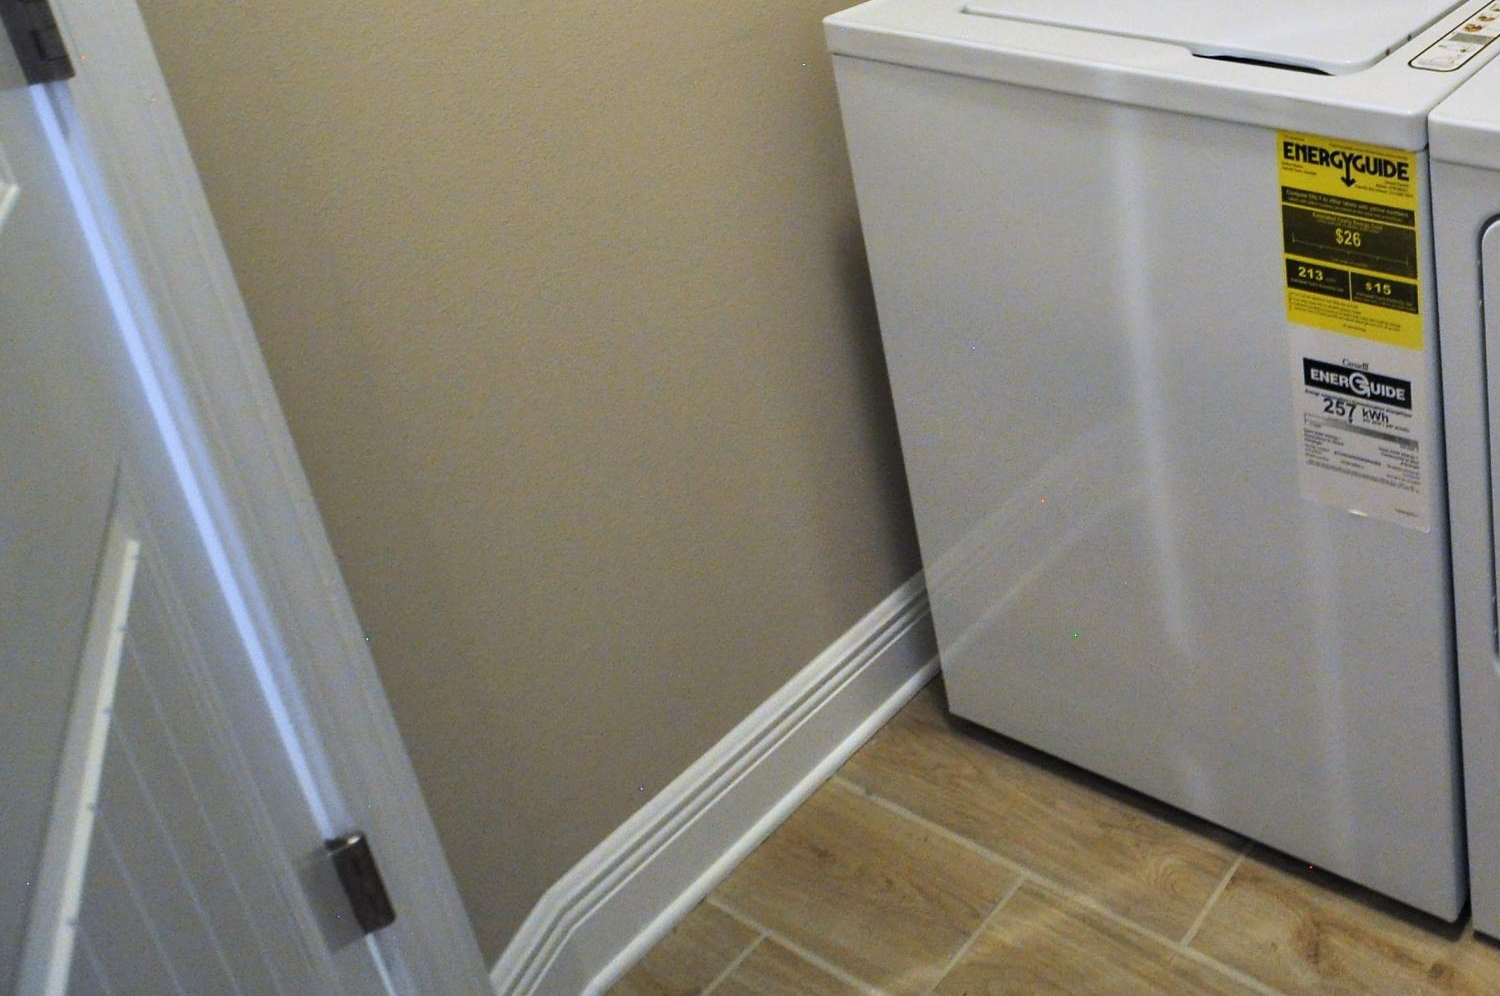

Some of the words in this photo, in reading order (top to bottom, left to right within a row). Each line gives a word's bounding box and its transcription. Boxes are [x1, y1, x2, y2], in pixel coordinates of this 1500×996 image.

[1283, 140, 1410, 183] ENERGYGUIDE
[1335, 227, 1361, 247] $26
[1297, 266, 1324, 281] 213
[1365, 282, 1391, 296] $15
[1310, 368, 1406, 402] ENERGUIDE
[1323, 398, 1357, 422] 257
[1361, 407, 1389, 424] kWh
